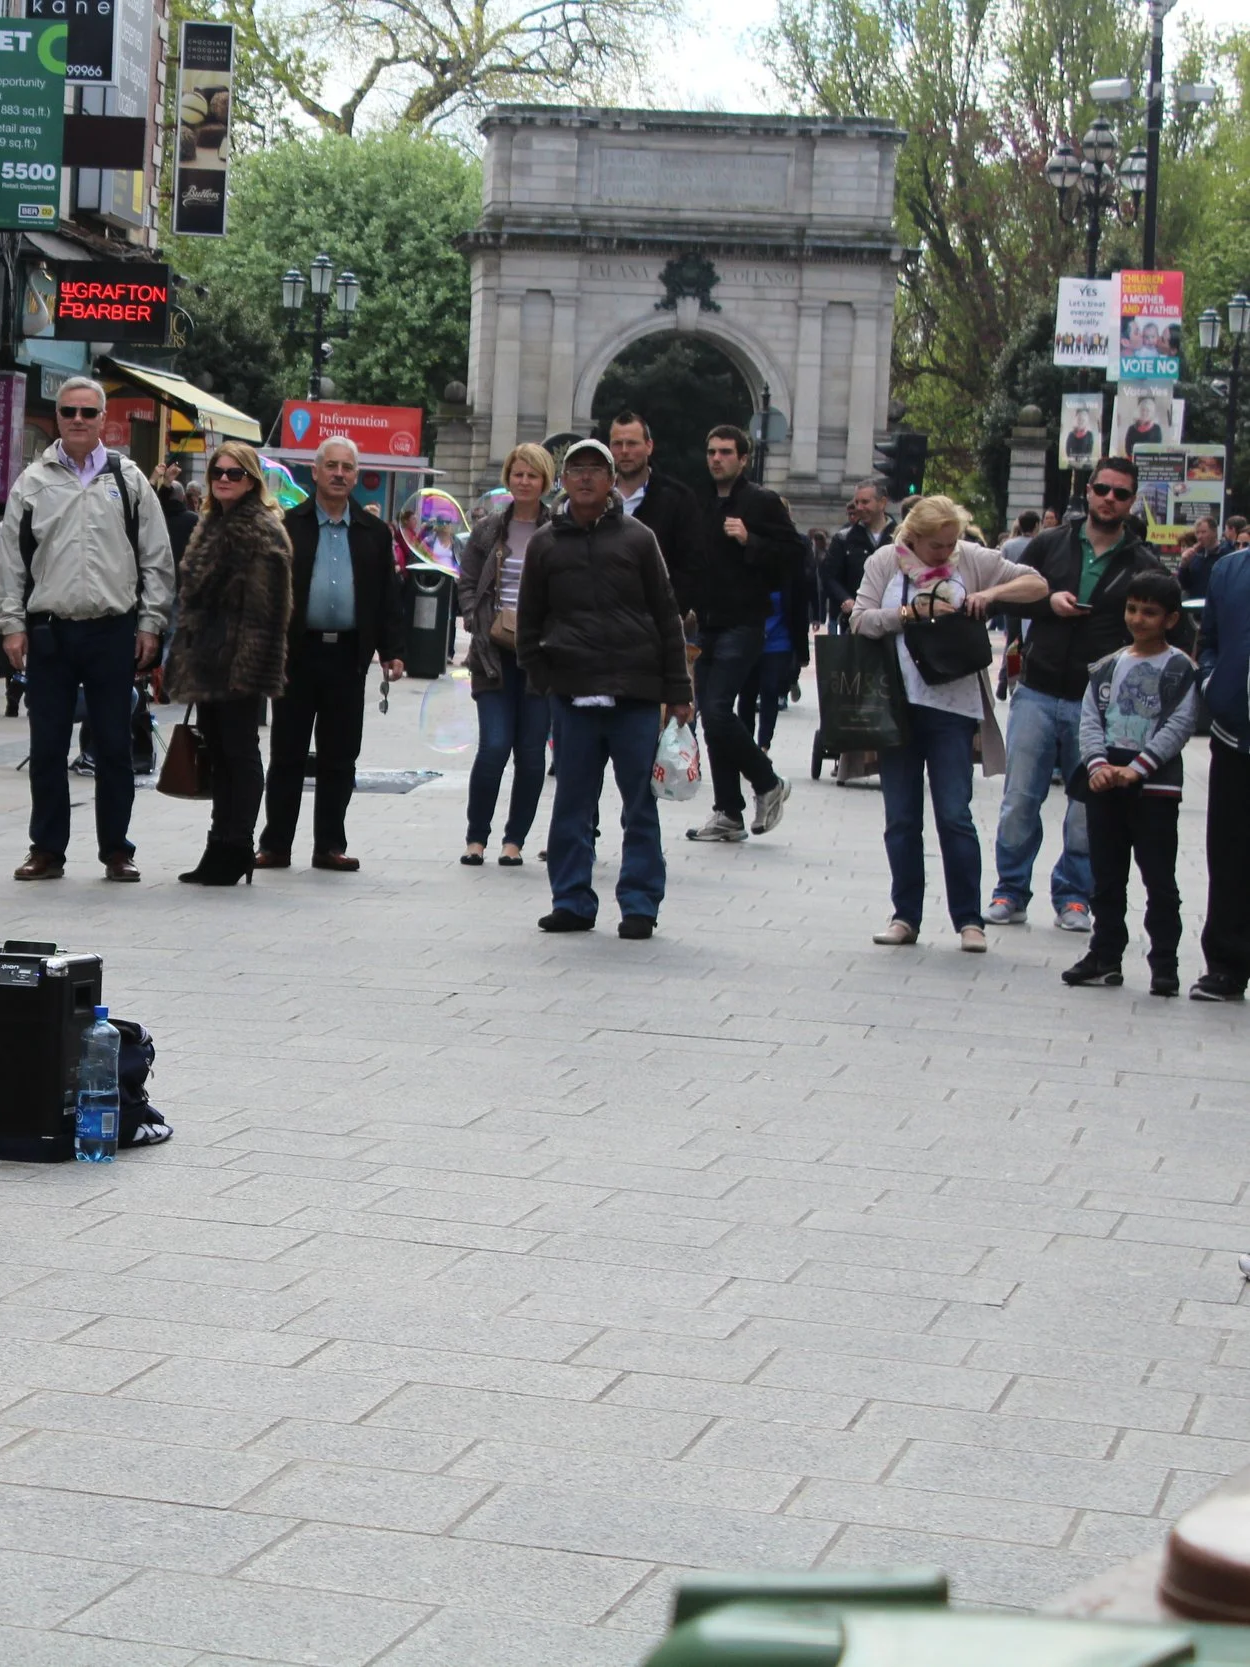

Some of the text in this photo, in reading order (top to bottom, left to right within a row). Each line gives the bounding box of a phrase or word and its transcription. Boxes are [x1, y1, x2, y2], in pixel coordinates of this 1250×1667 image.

[32, 0, 110, 15] kane
[187, 39, 227, 47] CHOCOLATE
[19, 125, 42, 134] area
[9, 138, 38, 150] sq.ft.)
[1, 162, 56, 181] 5500
[20, 184, 55, 192] Department
[181, 185, 220, 202] Butlers
[21, 207, 38, 216] BER
[1122, 274, 1164, 284] CHILDREN
[74, 282, 167, 303] GRAFTON
[1080, 284, 1098, 297] YES
[1122, 284, 1158, 294] DESERVE
[1069, 300, 1106, 308] Let's treat
[1122, 294, 1164, 305] A MOTHER
[72, 303, 151, 321] BARBER
[1070, 310, 1104, 318] everyone
[1122, 304, 1180, 315] AND A FATHER
[1073, 318, 1100, 327] equally
[1121, 358, 1178, 374] VOTE NO
[1123, 386, 1168, 397] Vote Yes
[319, 412, 389, 428] Information
[319, 427, 349, 438] Point
